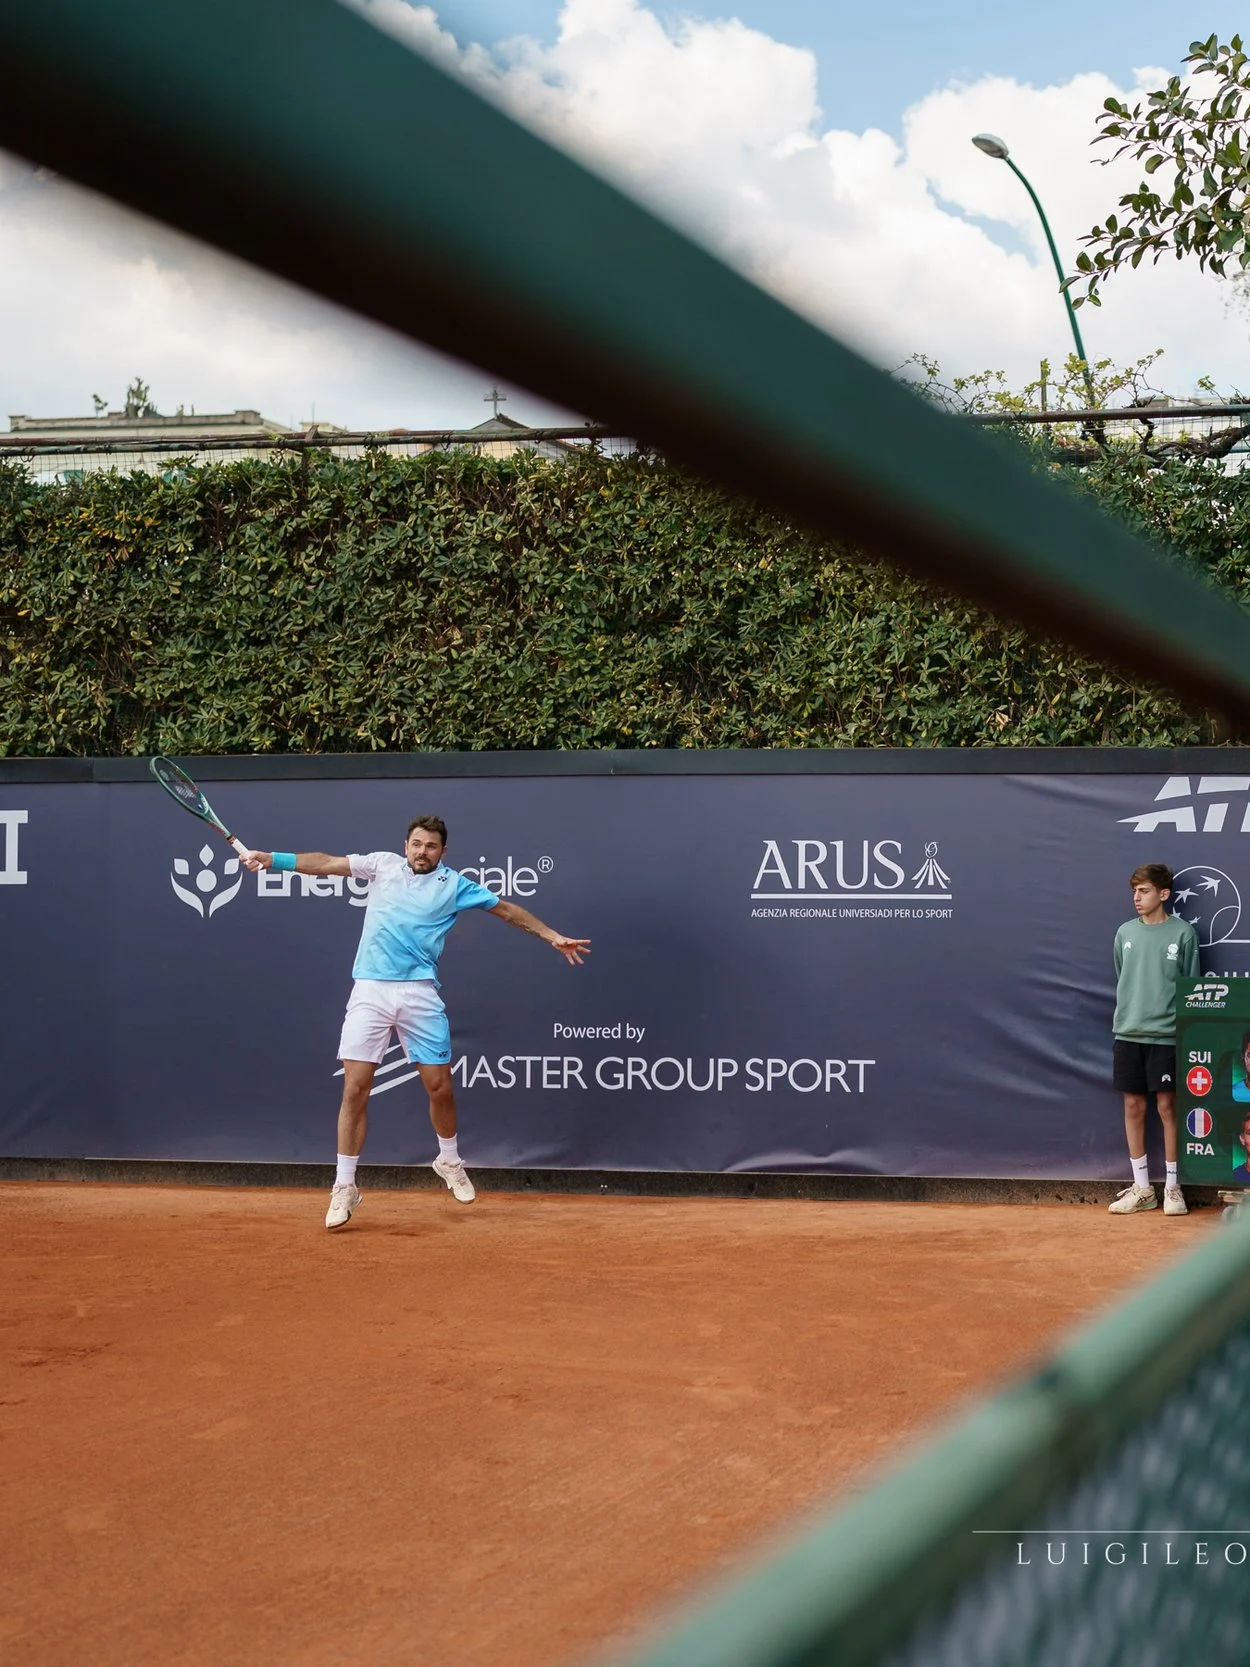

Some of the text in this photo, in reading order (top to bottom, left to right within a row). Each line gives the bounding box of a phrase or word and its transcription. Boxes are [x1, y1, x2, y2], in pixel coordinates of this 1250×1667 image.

[752, 840, 905, 890] ARUS
[751, 908, 953, 918] AGENZIA REGIONALE UNIVERSIADI PER LO SPORT
[1184, 984, 1229, 1001] ATP
[1185, 1001, 1226, 1009] CHALLENGER
[553, 1023, 646, 1043] Powered by
[1188, 1051, 1212, 1064] SUI
[450, 1055, 876, 1093] MASTER GROUP SPORT
[1186, 1143, 1215, 1156] FRA
